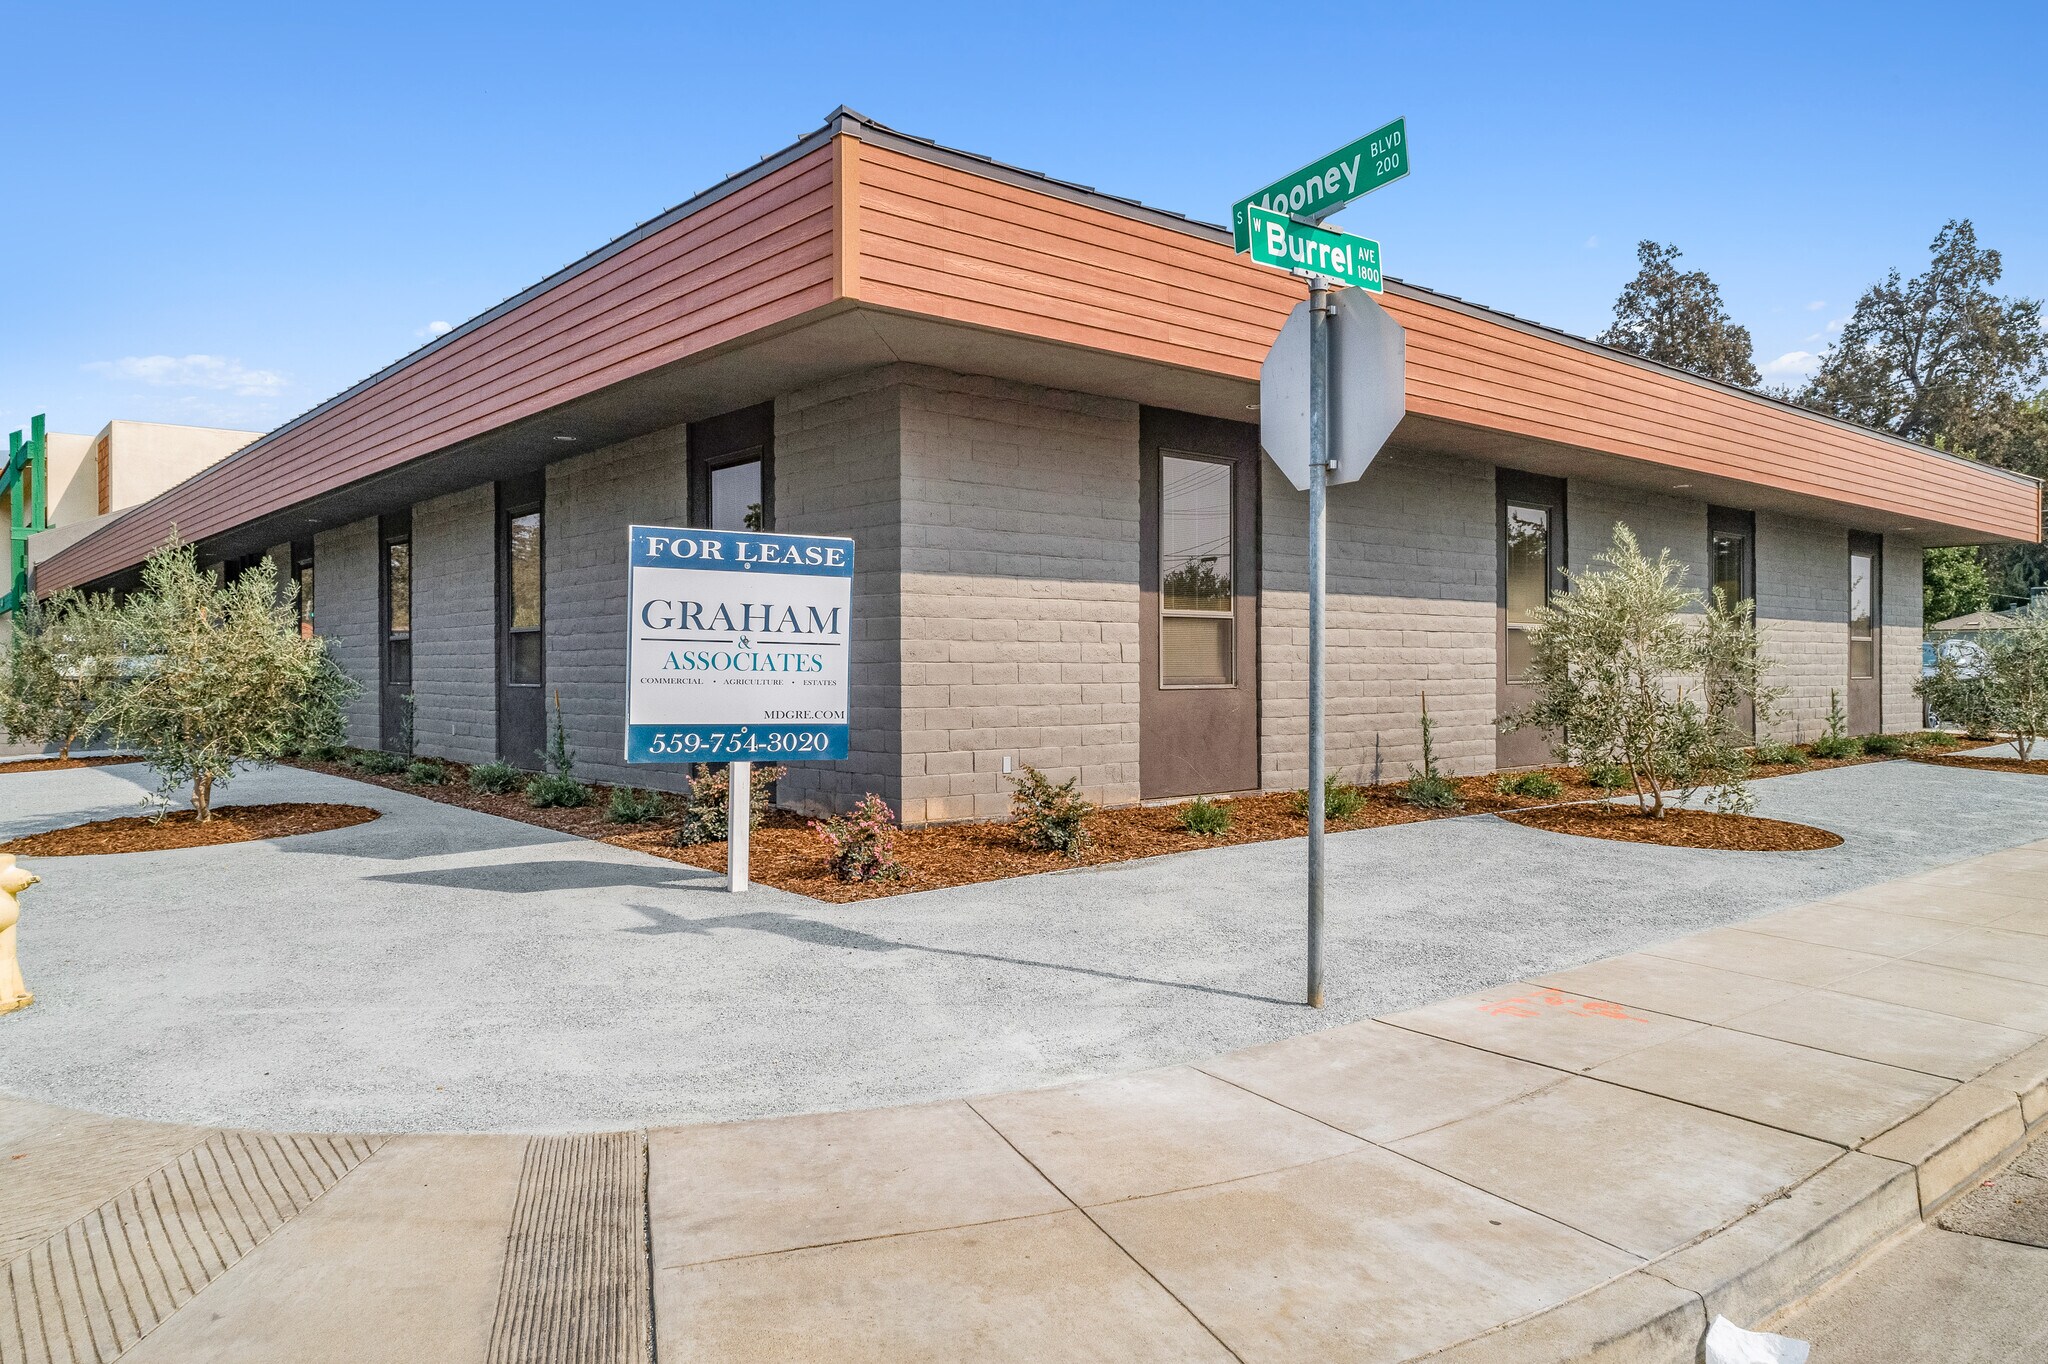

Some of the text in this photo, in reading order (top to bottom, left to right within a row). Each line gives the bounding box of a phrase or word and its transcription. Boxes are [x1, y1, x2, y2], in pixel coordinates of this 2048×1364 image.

[1376, 153, 1399, 176] 200
[1237, 211, 1243, 225] S
[1370, 131, 1401, 157] BLVD
[1253, 217, 1376, 275] W Burrel AVE
[1357, 265, 1379, 283] 1800
[646, 537, 846, 567] FOR LEASE
[641, 599, 842, 635] GRAHAM
[738, 635, 751, 650] &
[662, 651, 823, 673] ASSOCIATES
[640, 677, 704, 685] COMMERCIAL
[723, 678, 784, 686] AGRICULTURE
[764, 710, 845, 720] MDGRE.COM
[649, 732, 829, 754] 559-754-3020
